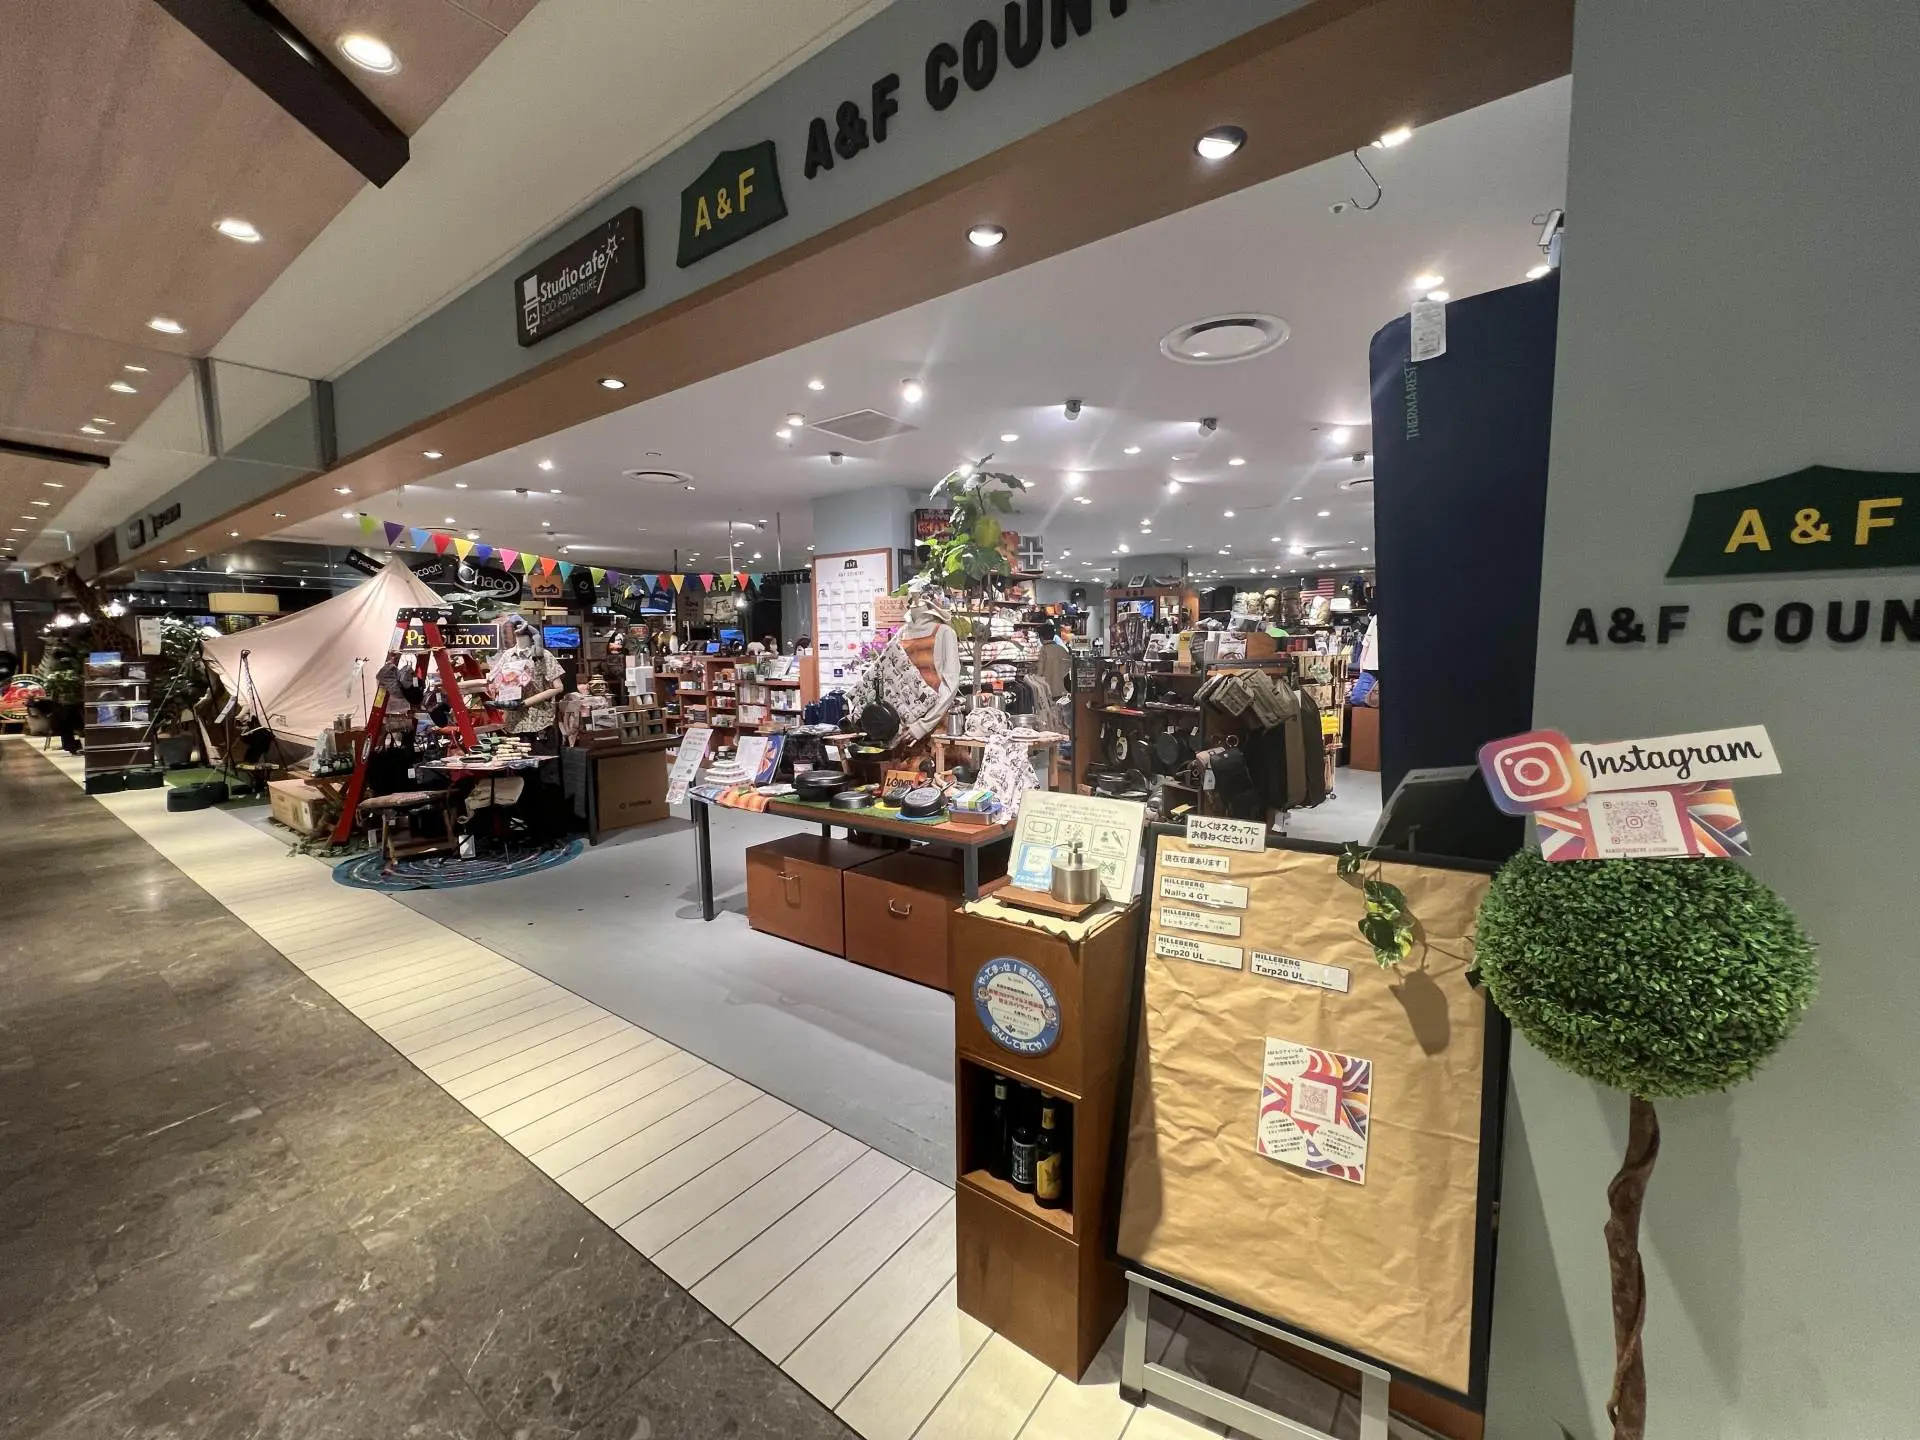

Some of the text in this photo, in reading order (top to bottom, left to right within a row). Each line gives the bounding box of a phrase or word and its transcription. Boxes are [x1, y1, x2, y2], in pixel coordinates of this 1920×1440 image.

[803, 0, 1128, 179] A&F COUN
[557, 276, 600, 307] ADVENTURE
[458, 560, 514, 592] Chaco
[1566, 605, 1690, 645] A&F
[406, 630, 493, 646] PELETON
[1579, 737, 1763, 780] Instagram
[1191, 819, 1260, 836] 詳しくはスタッフに
[1191, 830, 1255, 846] お尋ねください！
[1165, 854, 1228, 869] 現在在庫あります！
[1164, 878, 1206, 889] HILLEBERG
[1188, 891, 1195, 899] 4
[1196, 893, 1210, 901] GT
[1163, 908, 1201, 919] HILLEBERG
[1158, 936, 1200, 949] HILLEBERG
[1160, 946, 1191, 958] Tarp20
[1192, 951, 1205, 961] UL
[1255, 953, 1301, 967] HILLEBERG
[1256, 964, 1289, 977] Tarp20
[1291, 971, 1305, 981] UL
